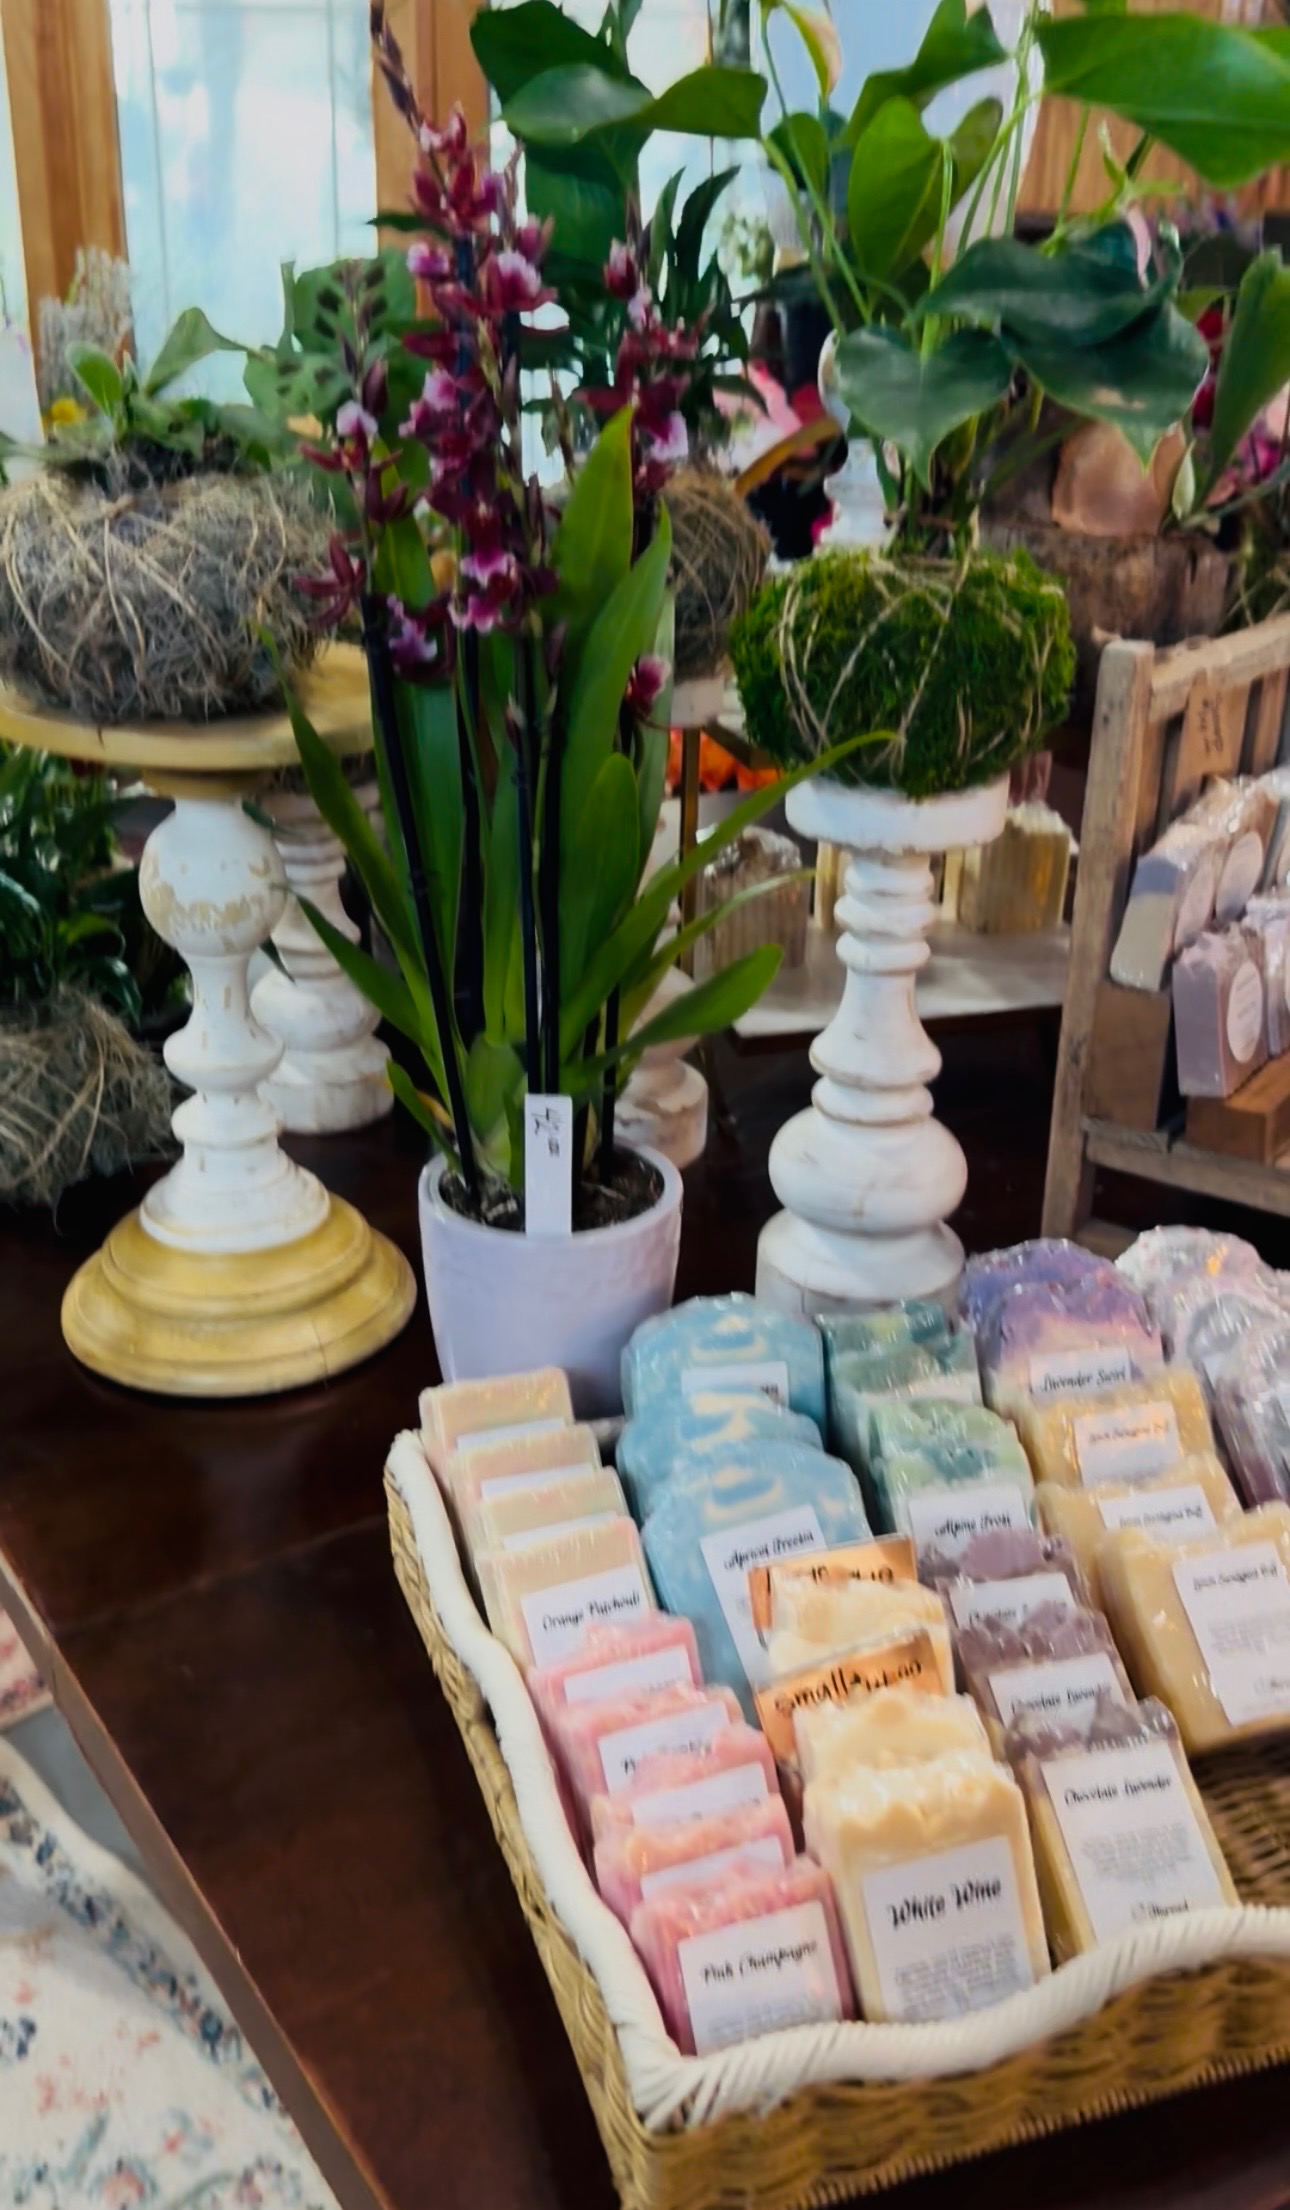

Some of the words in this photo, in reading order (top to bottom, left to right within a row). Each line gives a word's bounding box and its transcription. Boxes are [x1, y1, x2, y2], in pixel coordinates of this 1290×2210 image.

[1064, 1784, 1118, 1807] Chocolate
[888, 1894, 946, 1930] White
[949, 1876, 1001, 1911] Wine
[703, 1960, 734, 1985] Pink
[738, 1939, 817, 1978] Champagne
